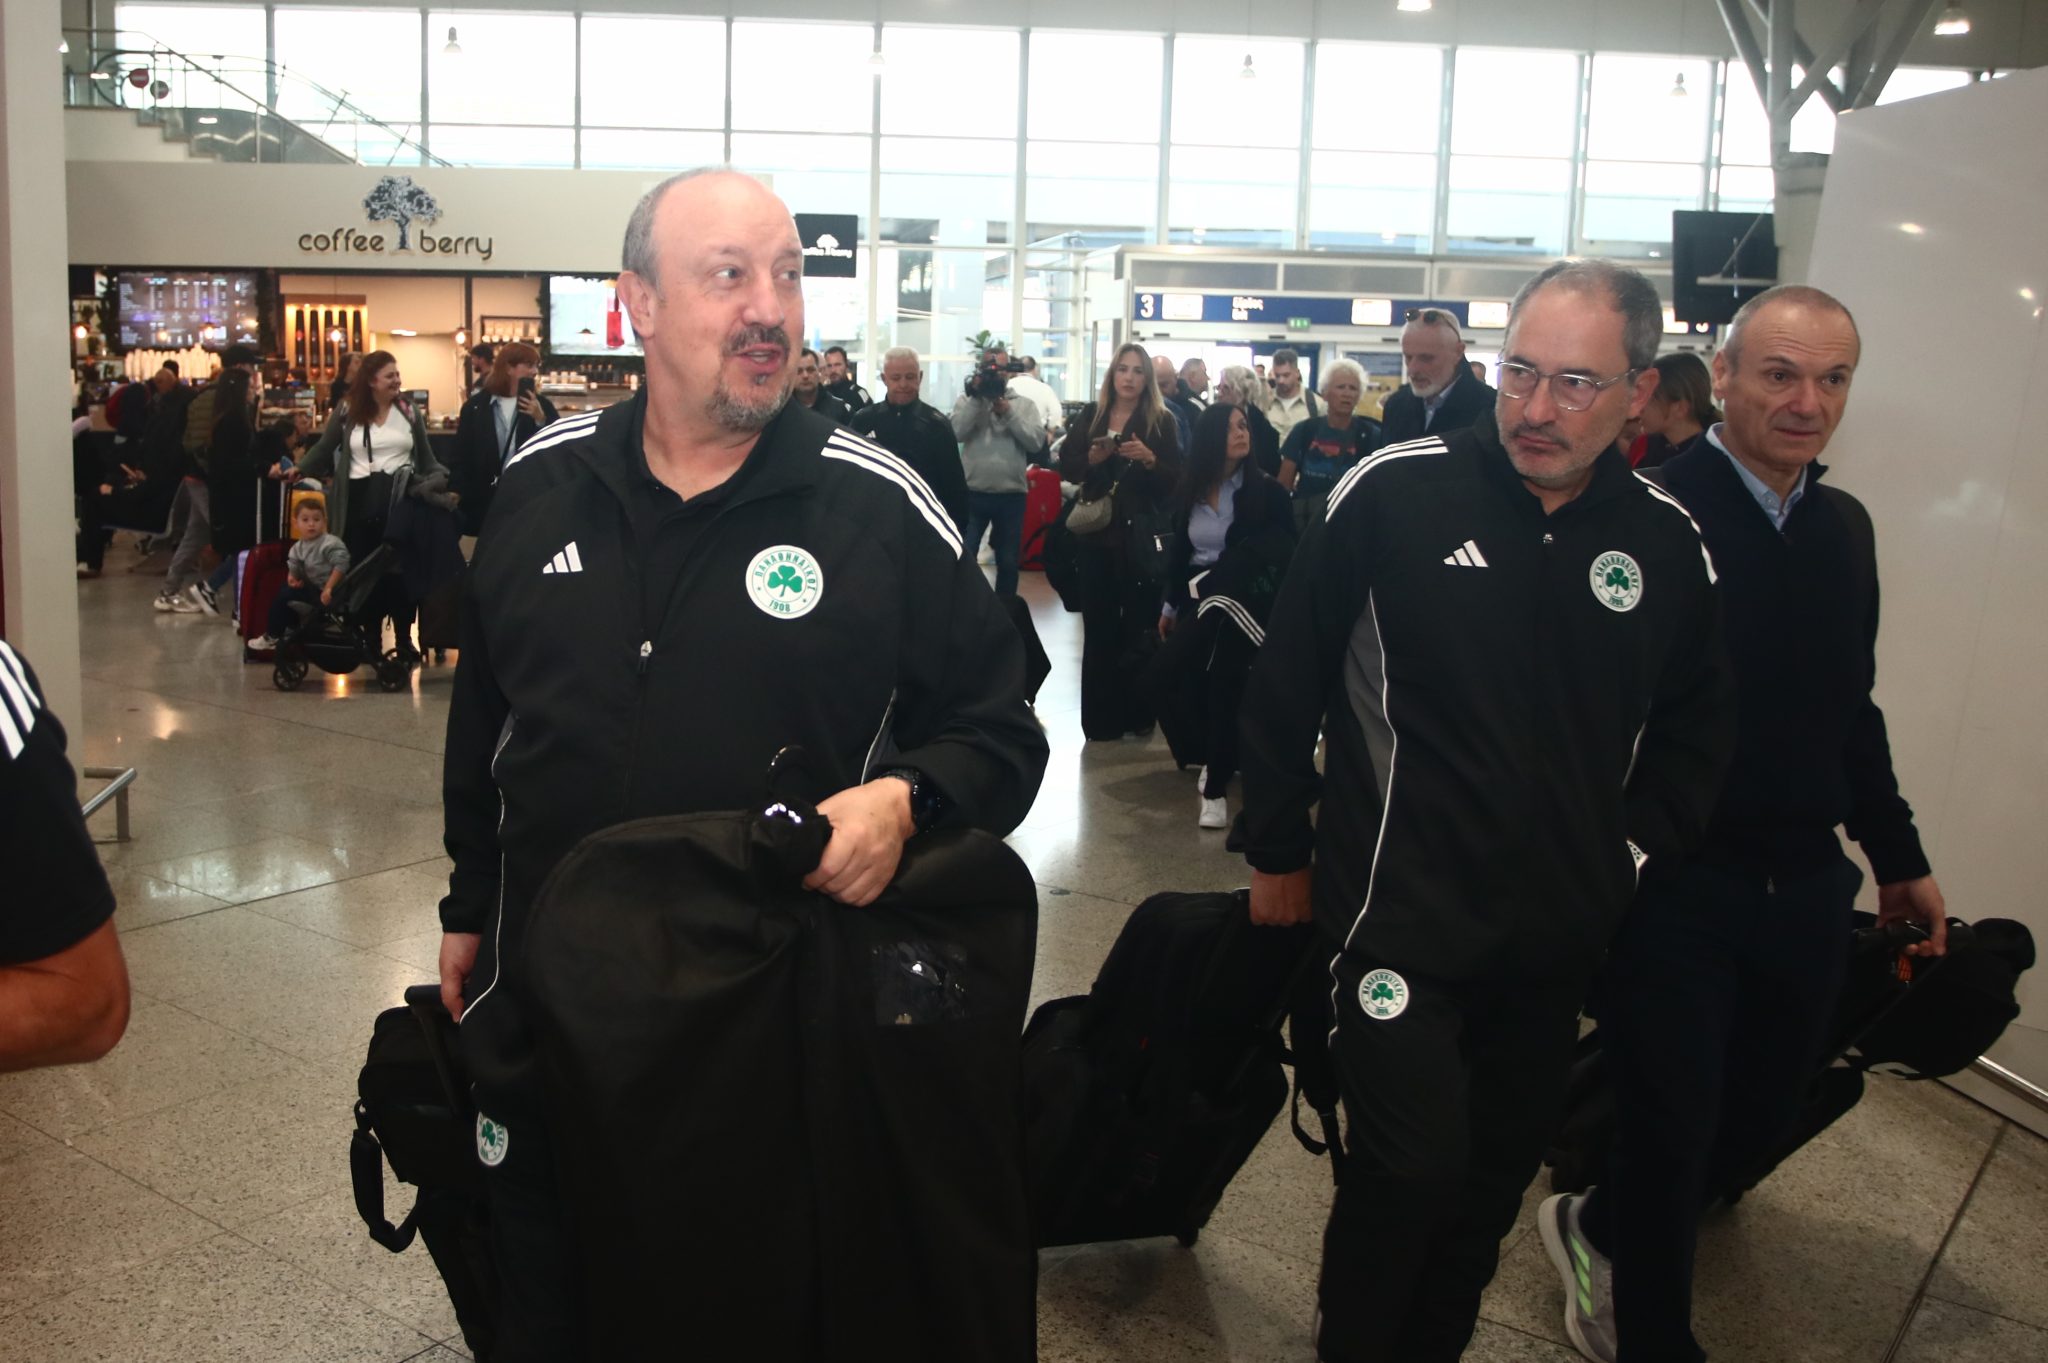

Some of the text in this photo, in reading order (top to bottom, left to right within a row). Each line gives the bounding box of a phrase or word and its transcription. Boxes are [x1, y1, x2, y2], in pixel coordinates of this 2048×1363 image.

[298, 228, 493, 261] coffee berry
[1140, 294, 1155, 319] 3
[769, 600, 792, 613] 1908
